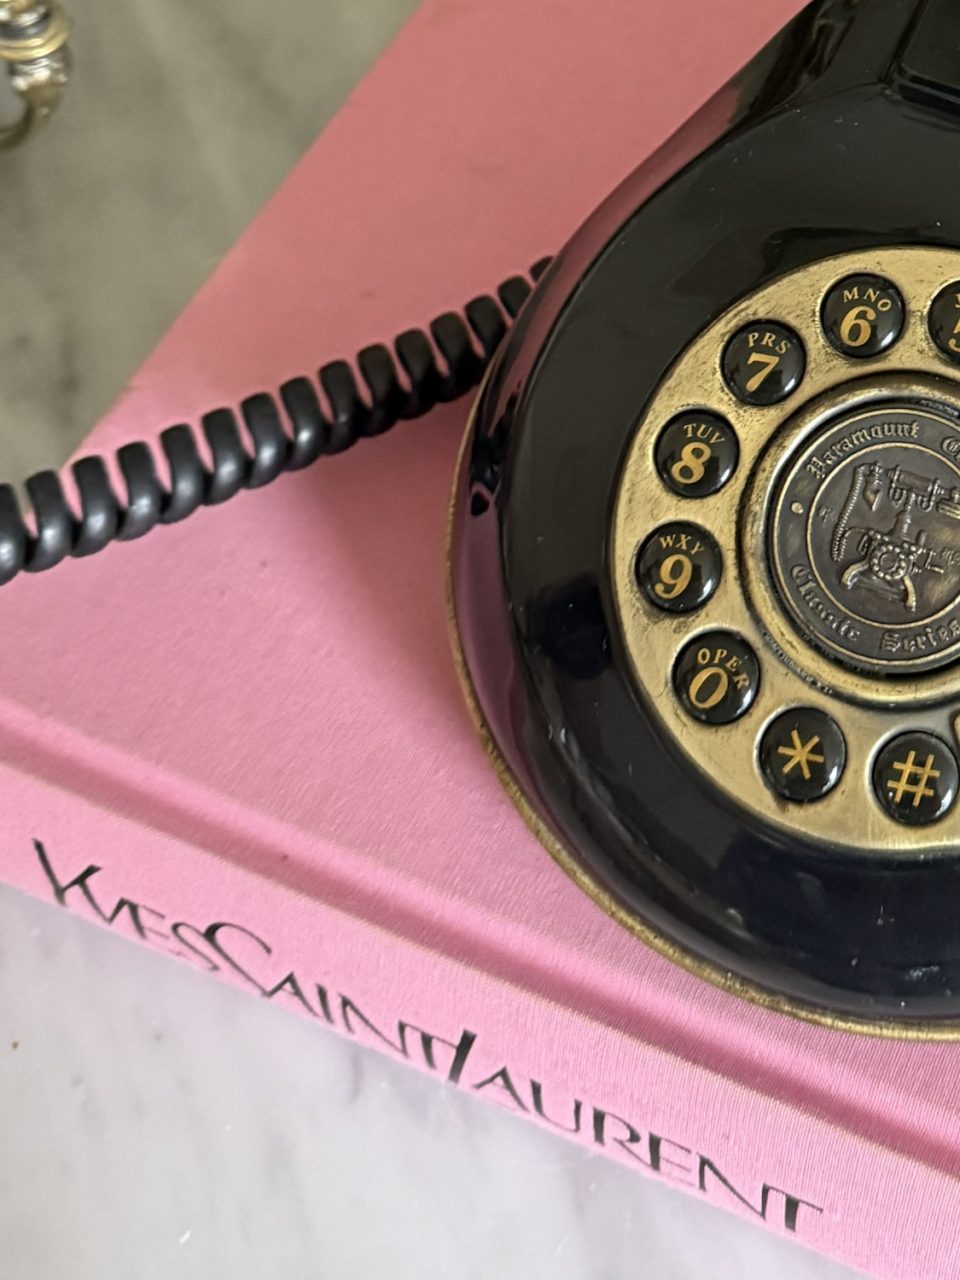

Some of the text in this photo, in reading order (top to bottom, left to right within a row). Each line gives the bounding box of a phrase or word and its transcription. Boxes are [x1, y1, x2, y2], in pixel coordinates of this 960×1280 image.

[842, 287, 892, 312] MNO
[747, 332, 790, 355] PRS
[839, 305, 877, 348] 6
[744, 351, 780, 394] 7
[682, 422, 726, 447] TUV
[805, 421, 921, 480] Paramount
[670, 441, 712, 485] 8
[658, 534, 705, 556] WXY
[654, 553, 693, 600] 9
[688, 666, 729, 710] 0
[697, 647, 749, 690] OPER
